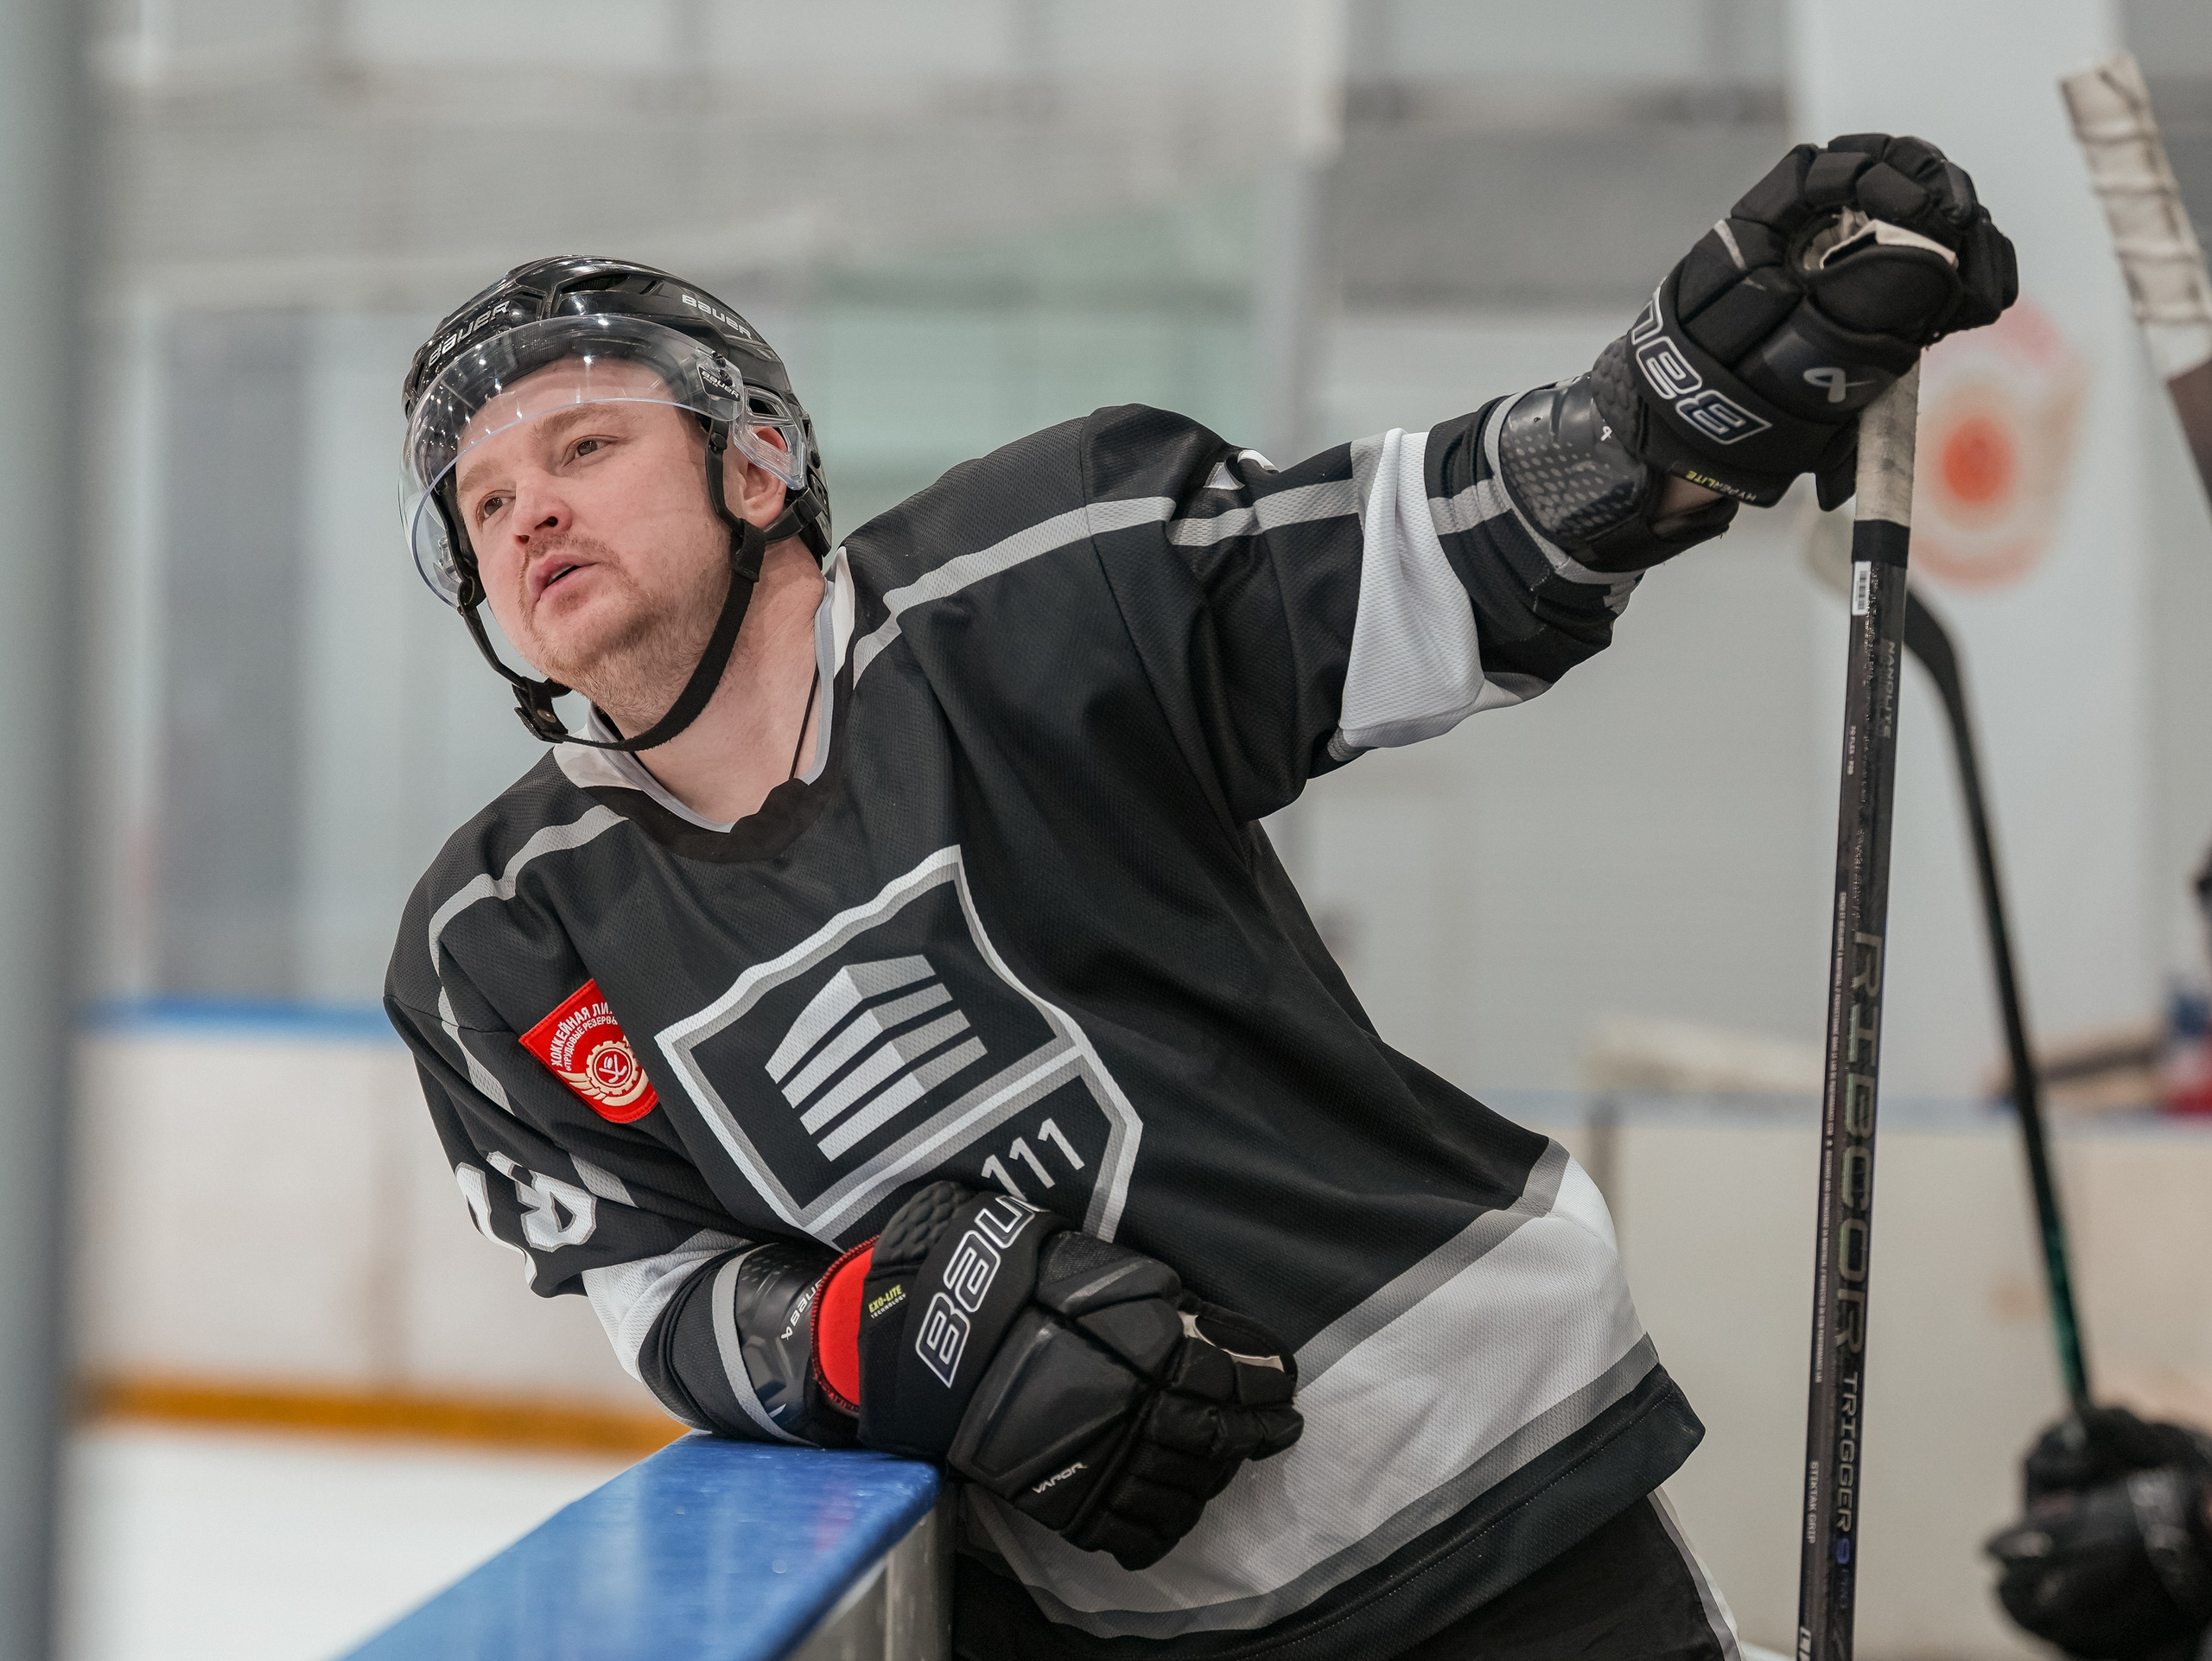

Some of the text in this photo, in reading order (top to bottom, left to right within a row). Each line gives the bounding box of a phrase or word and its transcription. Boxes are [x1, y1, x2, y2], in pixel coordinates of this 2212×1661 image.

[429, 300, 511, 366] BAUER
[682, 294, 753, 340] BAUER
[702, 371, 740, 398] BAUER
[550, 1002, 613, 1066] ХОККЕЙНАЯ ЛИ
[982, 1117, 1085, 1200] 111
[1834, 931, 1883, 1352] RIBCOR
[868, 1283, 902, 1313] EXO-LITE
[870, 1292, 906, 1319] TECHNOLOGY
[915, 1194, 1041, 1388] BAU
[1032, 1462, 1088, 1493] VAPOR
[1835, 1371, 1859, 1531] TRIGGER
[1806, 1460, 1819, 1543] STIKTAK GRIP
